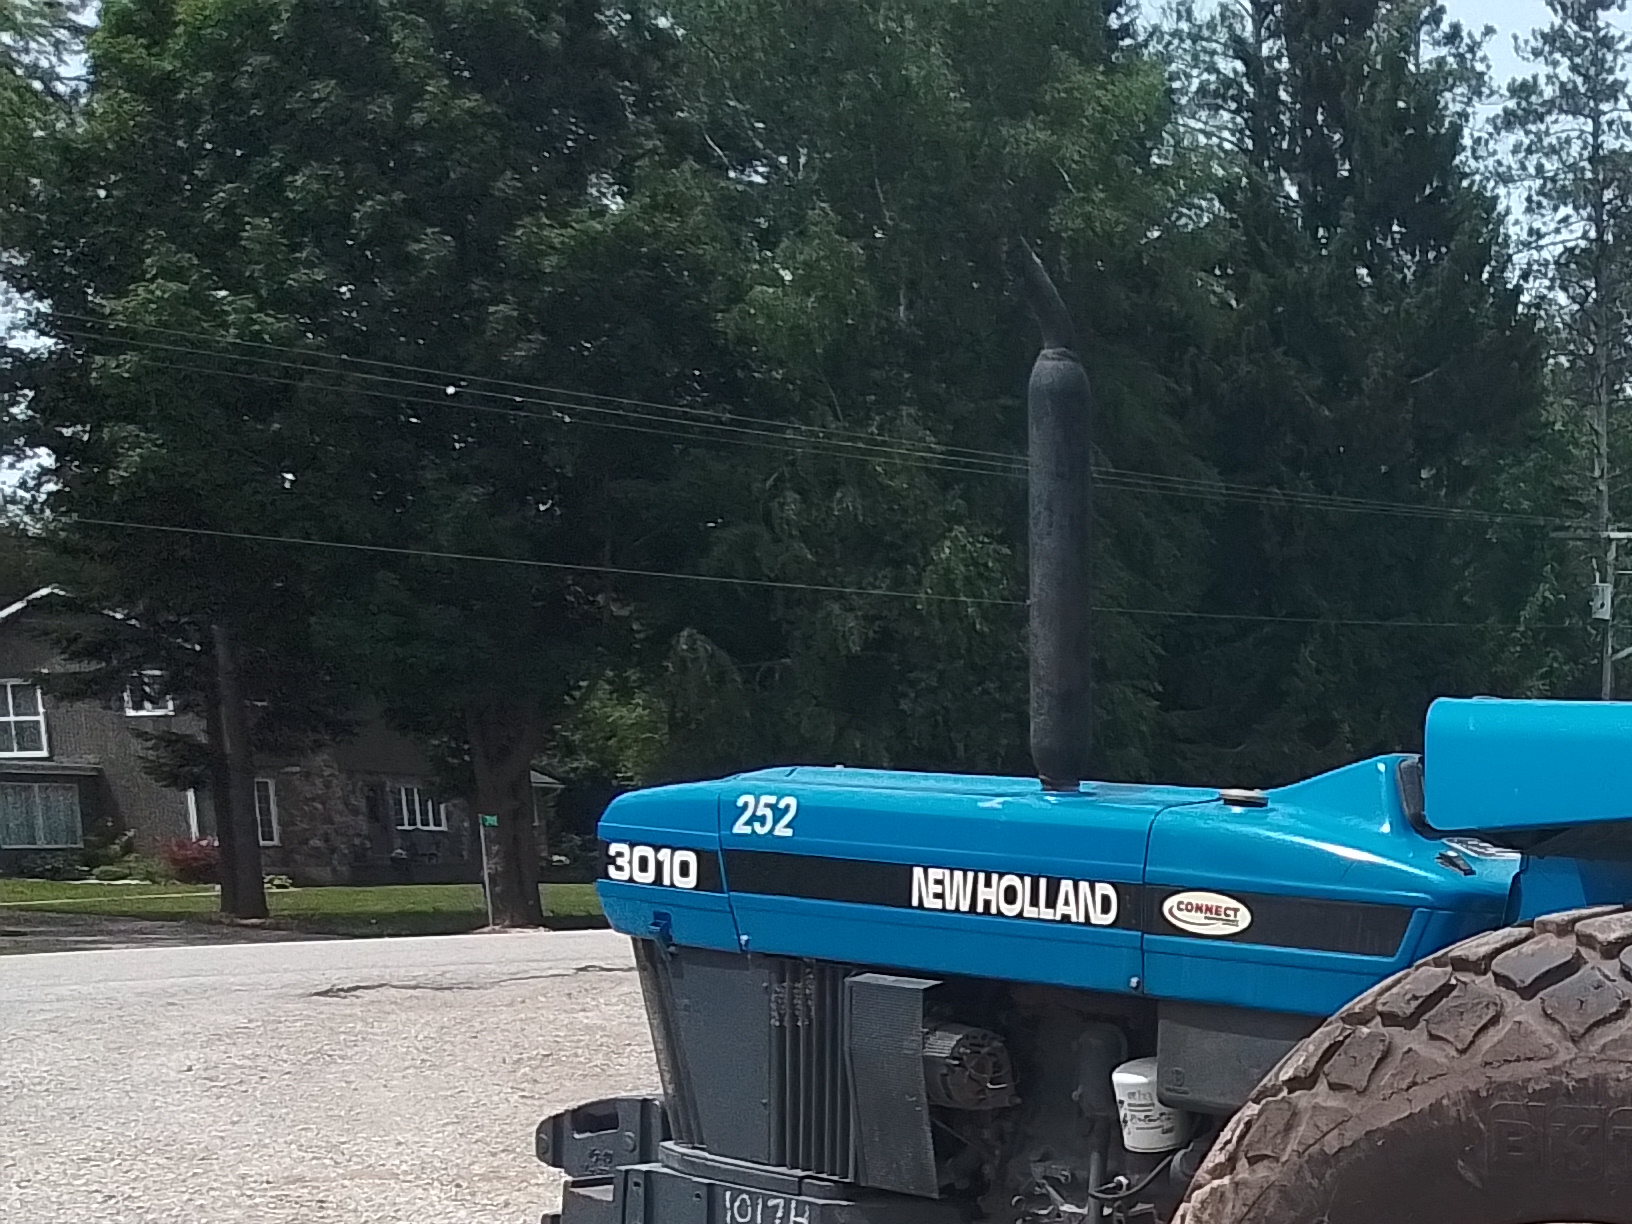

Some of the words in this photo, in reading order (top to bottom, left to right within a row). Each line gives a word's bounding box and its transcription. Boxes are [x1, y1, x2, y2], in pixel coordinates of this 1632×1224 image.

[731, 793, 798, 838] 252
[607, 842, 698, 889] 3010
[911, 866, 975, 912] NEW
[976, 870, 1118, 925] HOLLAND
[1175, 900, 1241, 919] CONNECT
